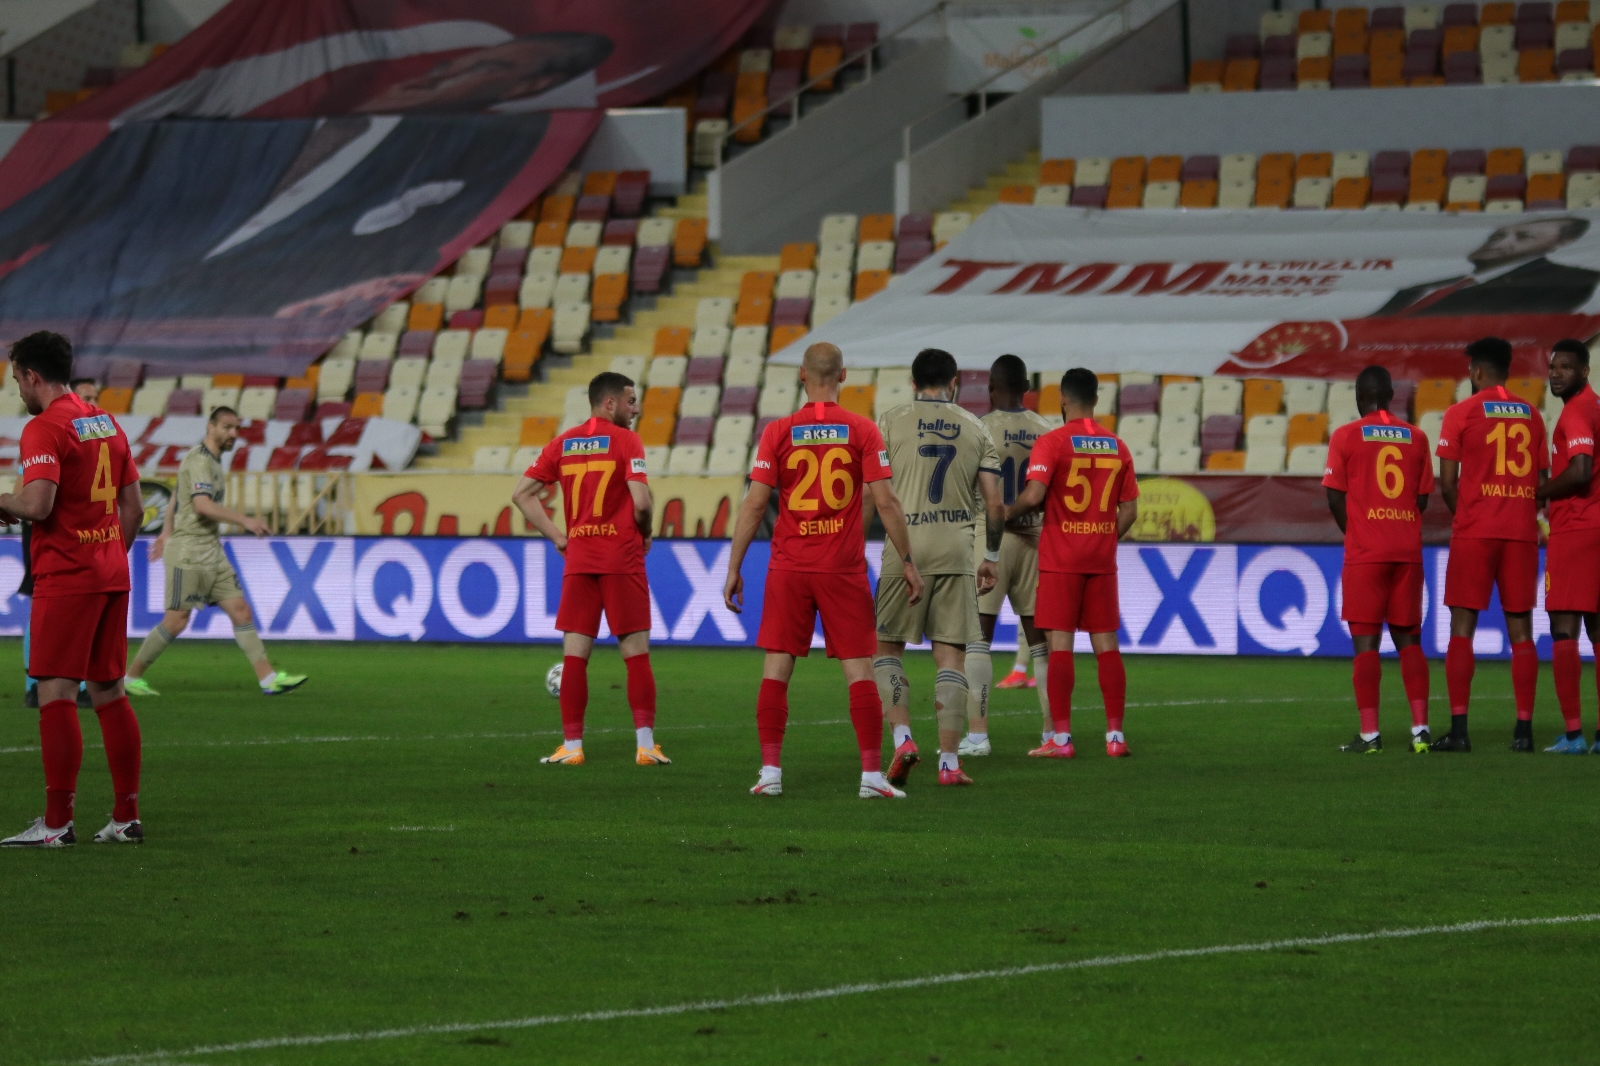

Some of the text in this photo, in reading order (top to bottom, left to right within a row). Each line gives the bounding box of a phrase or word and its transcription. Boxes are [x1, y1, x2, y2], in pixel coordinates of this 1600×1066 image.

[924, 258, 1229, 296] TMM
[1494, 404, 1524, 414] aksa
[571, 440, 600, 451] aksa
[803, 429, 838, 440] aksa
[917, 418, 961, 440] halley
[1081, 440, 1110, 449] aksa
[1372, 429, 1403, 439] aksa
[1486, 422, 1532, 478] 13
[91, 442, 116, 514] 4
[561, 460, 616, 519] 77
[787, 447, 854, 511] 26
[918, 444, 957, 504] 7
[1063, 458, 1122, 513] 57
[1376, 445, 1405, 499] 6
[1367, 508, 1415, 522] ACQUAH
